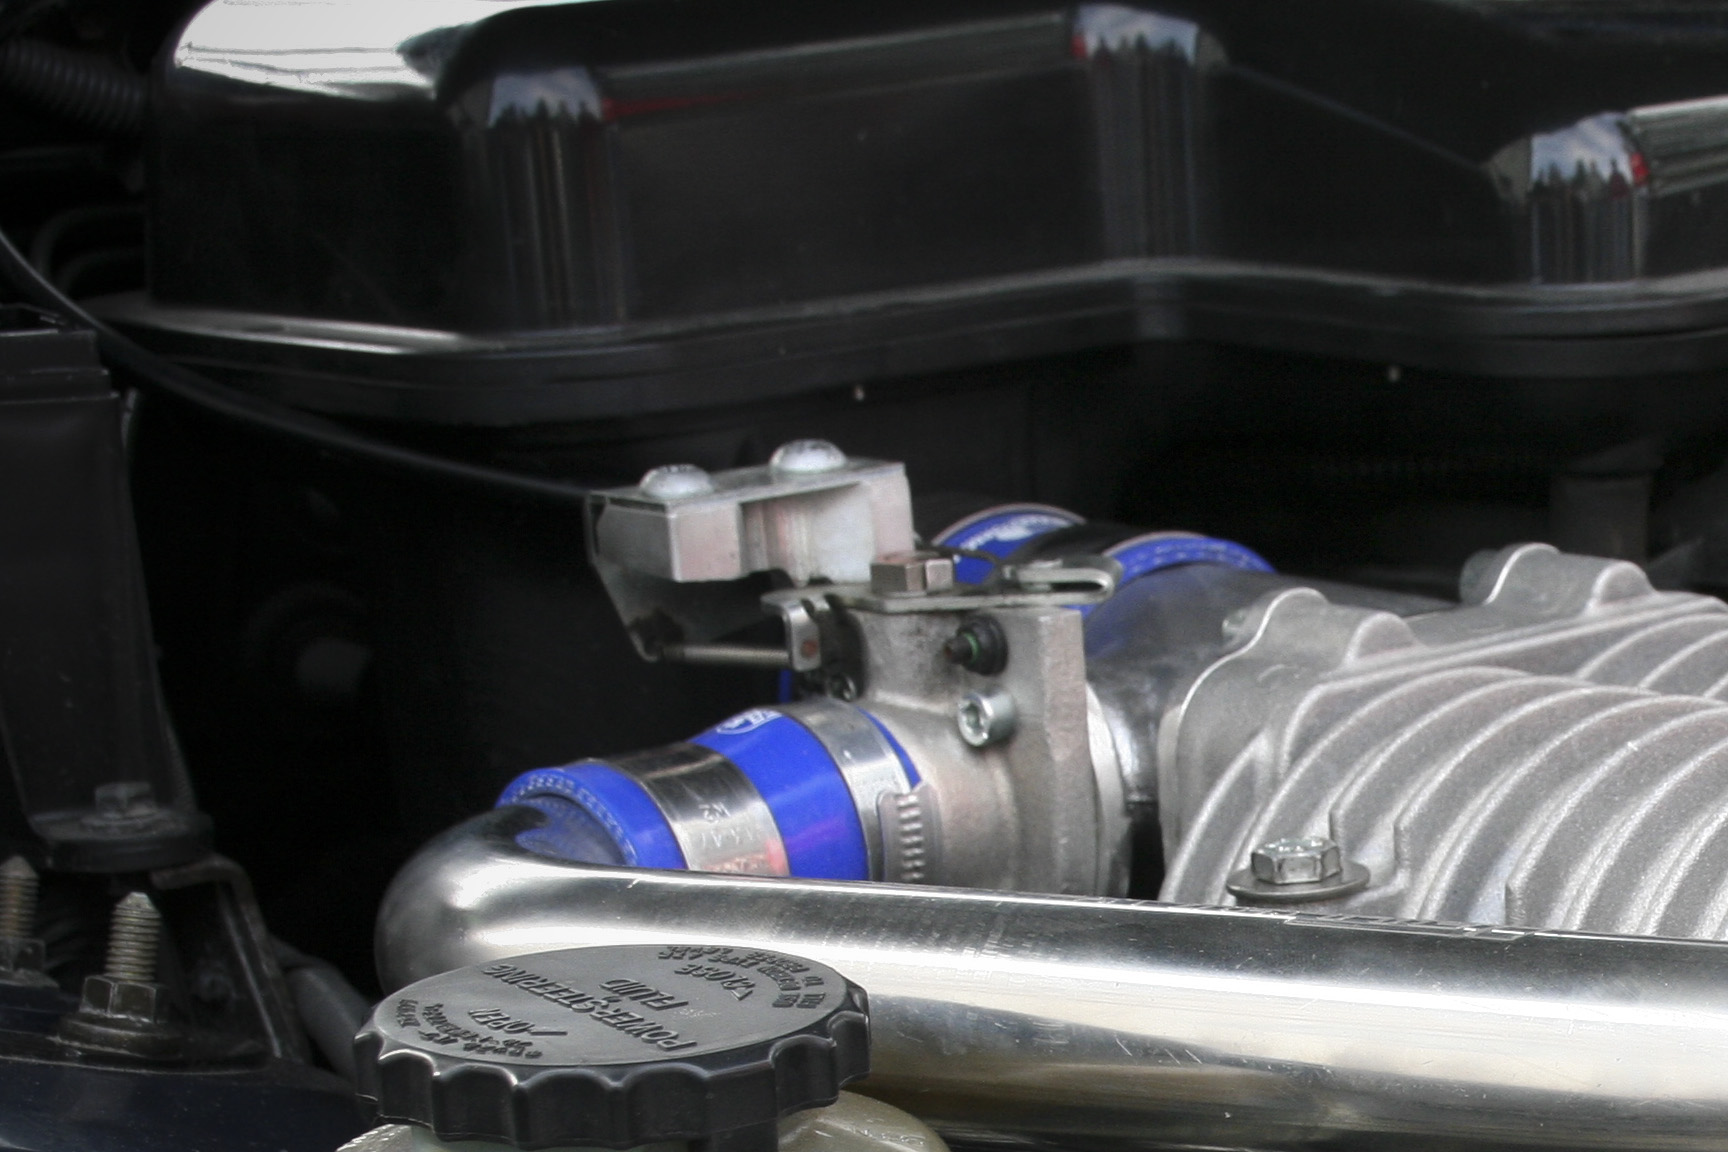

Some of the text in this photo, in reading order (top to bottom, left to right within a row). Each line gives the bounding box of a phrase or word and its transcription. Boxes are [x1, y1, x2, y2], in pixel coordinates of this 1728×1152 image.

[481, 963, 609, 1014] STEERING
[599, 977, 690, 1011] FLUID
[673, 963, 756, 992] CLOSE
[467, 1006, 533, 1035] OPEN
[590, 1006, 698, 1052] POWER
